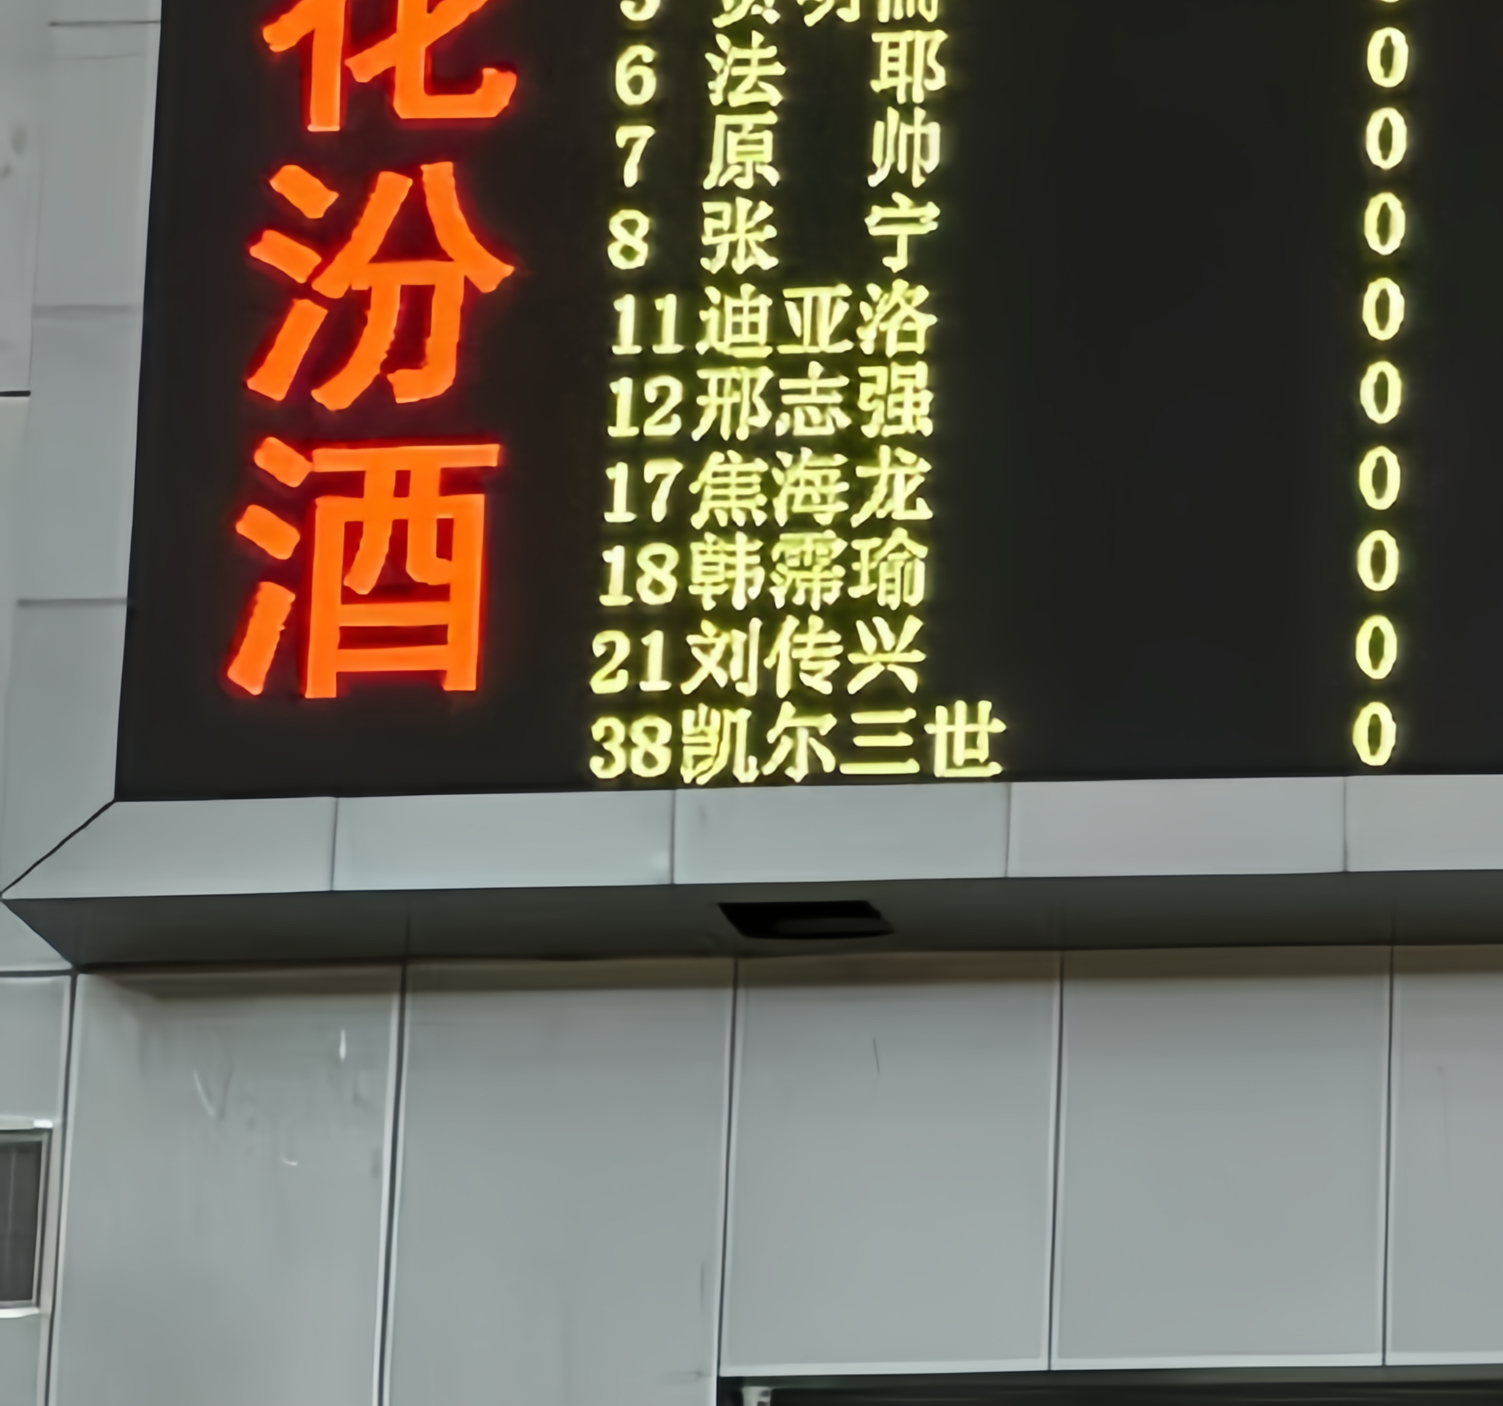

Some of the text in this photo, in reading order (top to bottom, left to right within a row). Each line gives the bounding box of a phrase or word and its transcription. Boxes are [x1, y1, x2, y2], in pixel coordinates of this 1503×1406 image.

[615, 44, 657, 106] 6
[1367, 27, 1409, 88] 0
[616, 125, 655, 187] 7
[1365, 107, 1408, 170] 0
[608, 209, 651, 270] 8
[1364, 192, 1406, 255] 0
[612, 279, 937, 358] 11 迪亚洛
[1362, 277, 1405, 341] 0
[608, 361, 934, 441] 12 邢志强
[1360, 361, 1403, 424] 0
[604, 445, 933, 529] 17 焦海龙
[1358, 446, 1401, 510] 0
[600, 543, 679, 606] 18
[1357, 530, 1399, 591] 0
[590, 615, 926, 698] 21 刘传兴
[1355, 615, 1398, 679] 0
[590, 700, 1006, 779] 38 凯尔三世
[1352, 702, 1397, 766] 0
